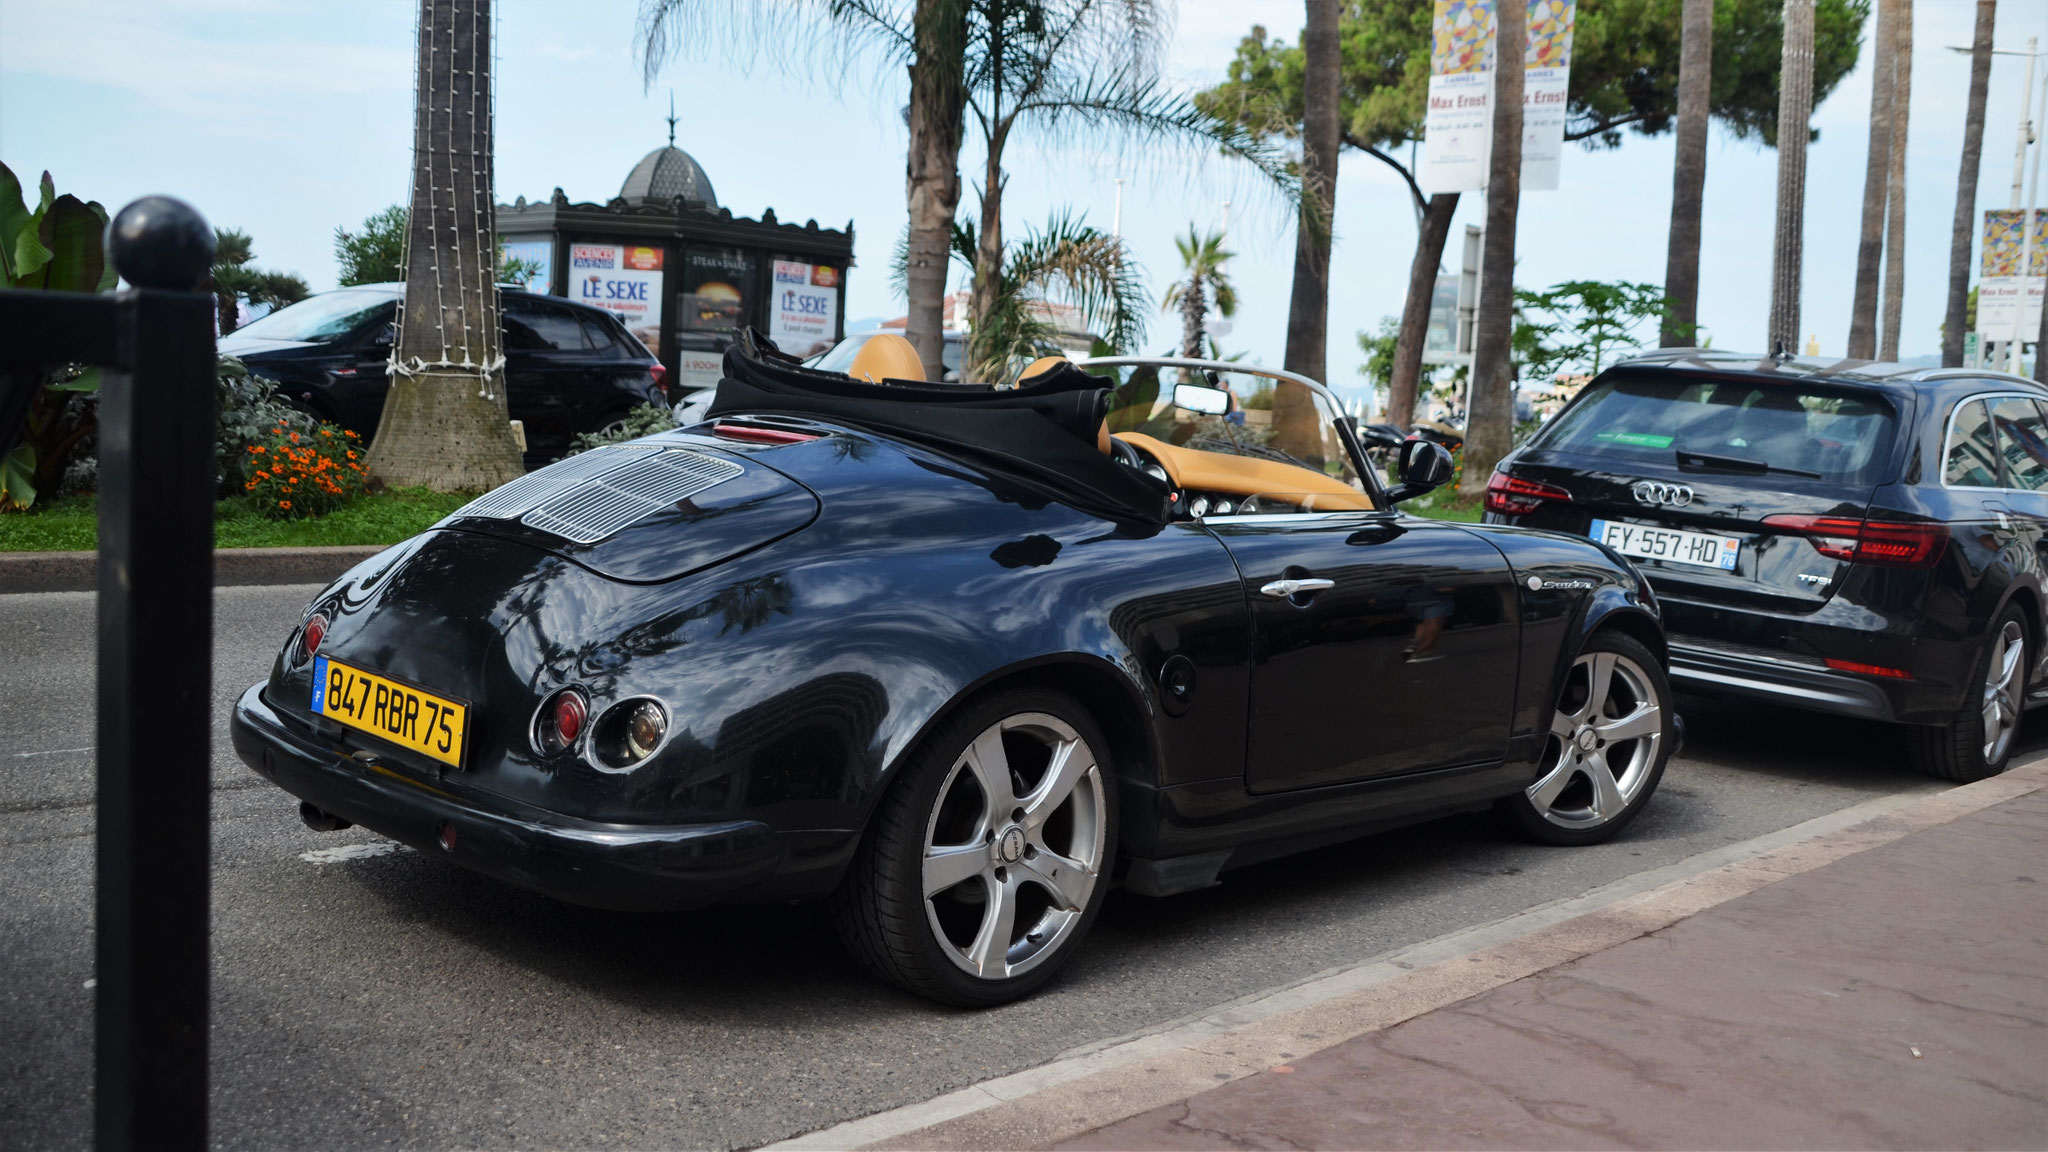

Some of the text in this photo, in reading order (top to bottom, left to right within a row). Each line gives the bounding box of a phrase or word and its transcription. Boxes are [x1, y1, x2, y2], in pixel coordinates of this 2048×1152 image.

[1430, 93, 1487, 109] Max Ernst
[1534, 89, 1565, 104] Ernst
[574, 246, 615, 259] SCIENCES
[574, 258, 615, 269] AVENIR
[582, 278, 649, 301] LE SEXE
[782, 292, 828, 315] LE SEXE
[1606, 525, 1717, 563] EY-557-HD
[1722, 553, 1736, 567] 76
[328, 667, 455, 754] 847 RBR 75
